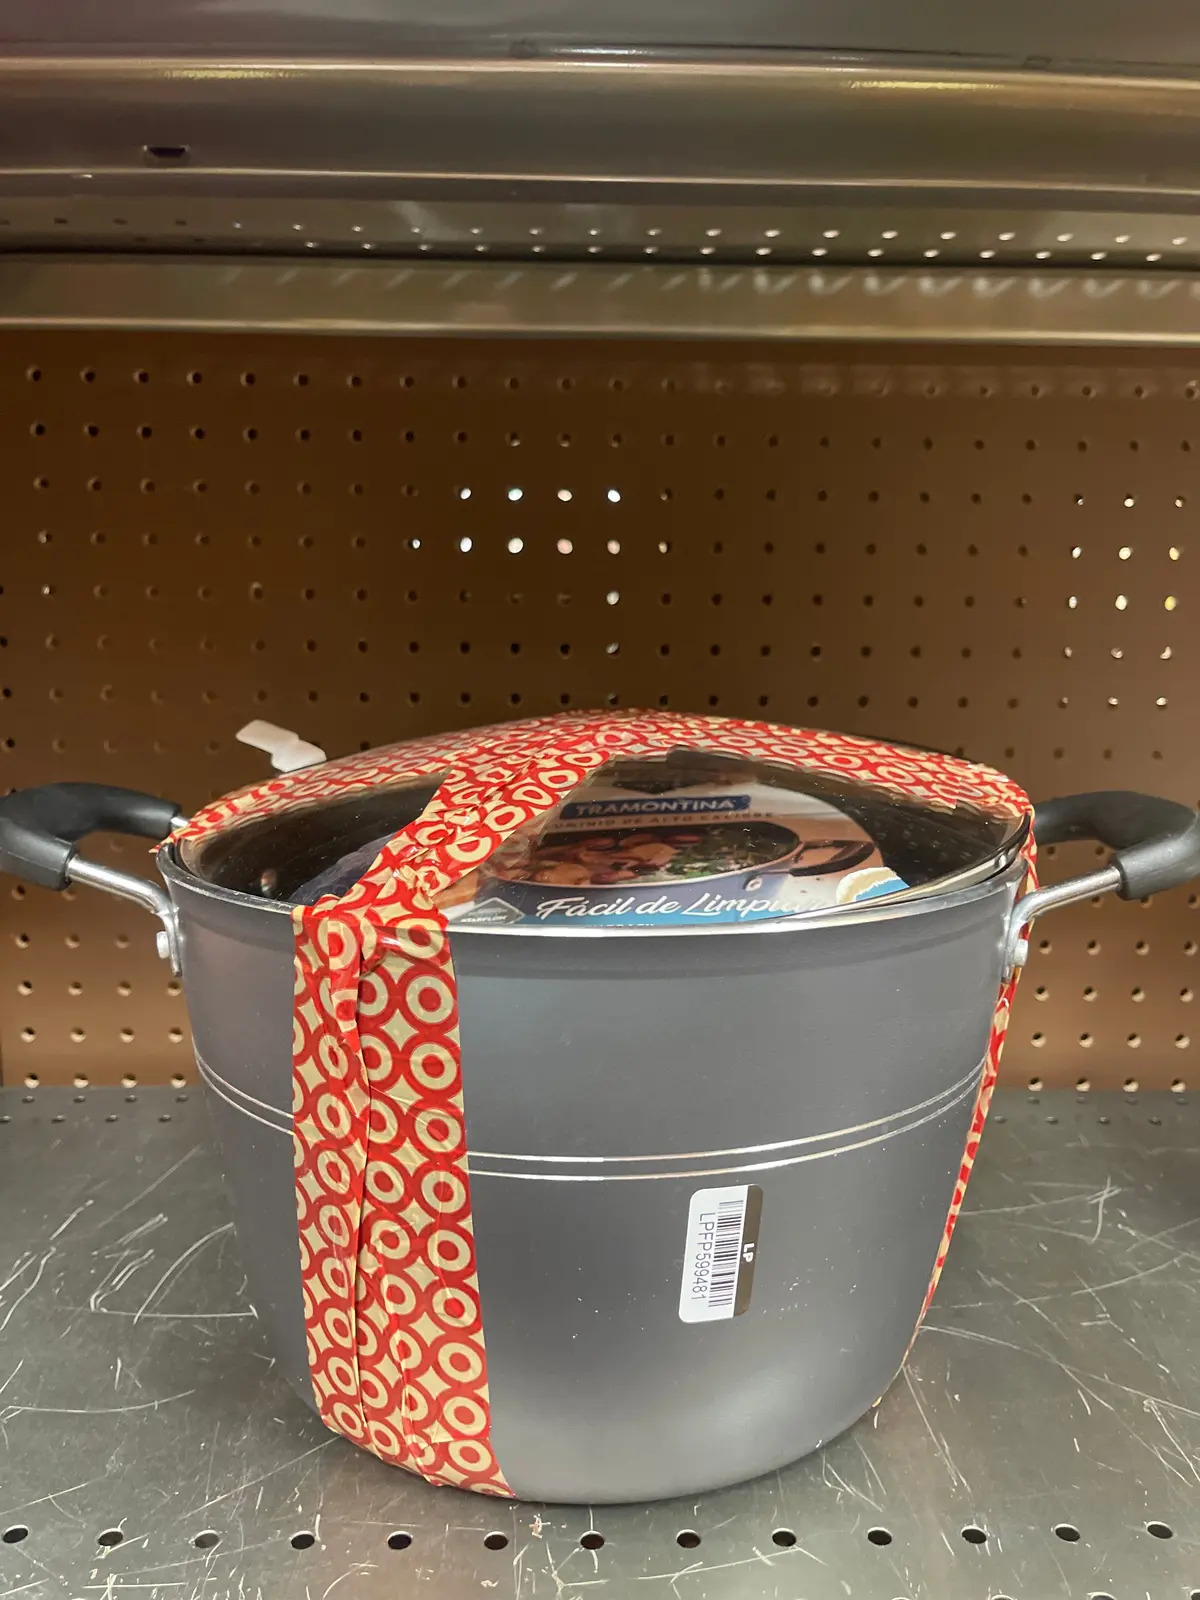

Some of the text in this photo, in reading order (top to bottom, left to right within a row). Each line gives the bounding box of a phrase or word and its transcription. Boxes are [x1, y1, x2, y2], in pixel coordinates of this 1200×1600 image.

[574, 799, 736, 816] TRAMONTINA
[535, 896, 633, 920] Fácil
[634, 895, 681, 914] de
[691, 1211, 716, 1300] LPFP599481
[743, 1242, 755, 1263] LP
